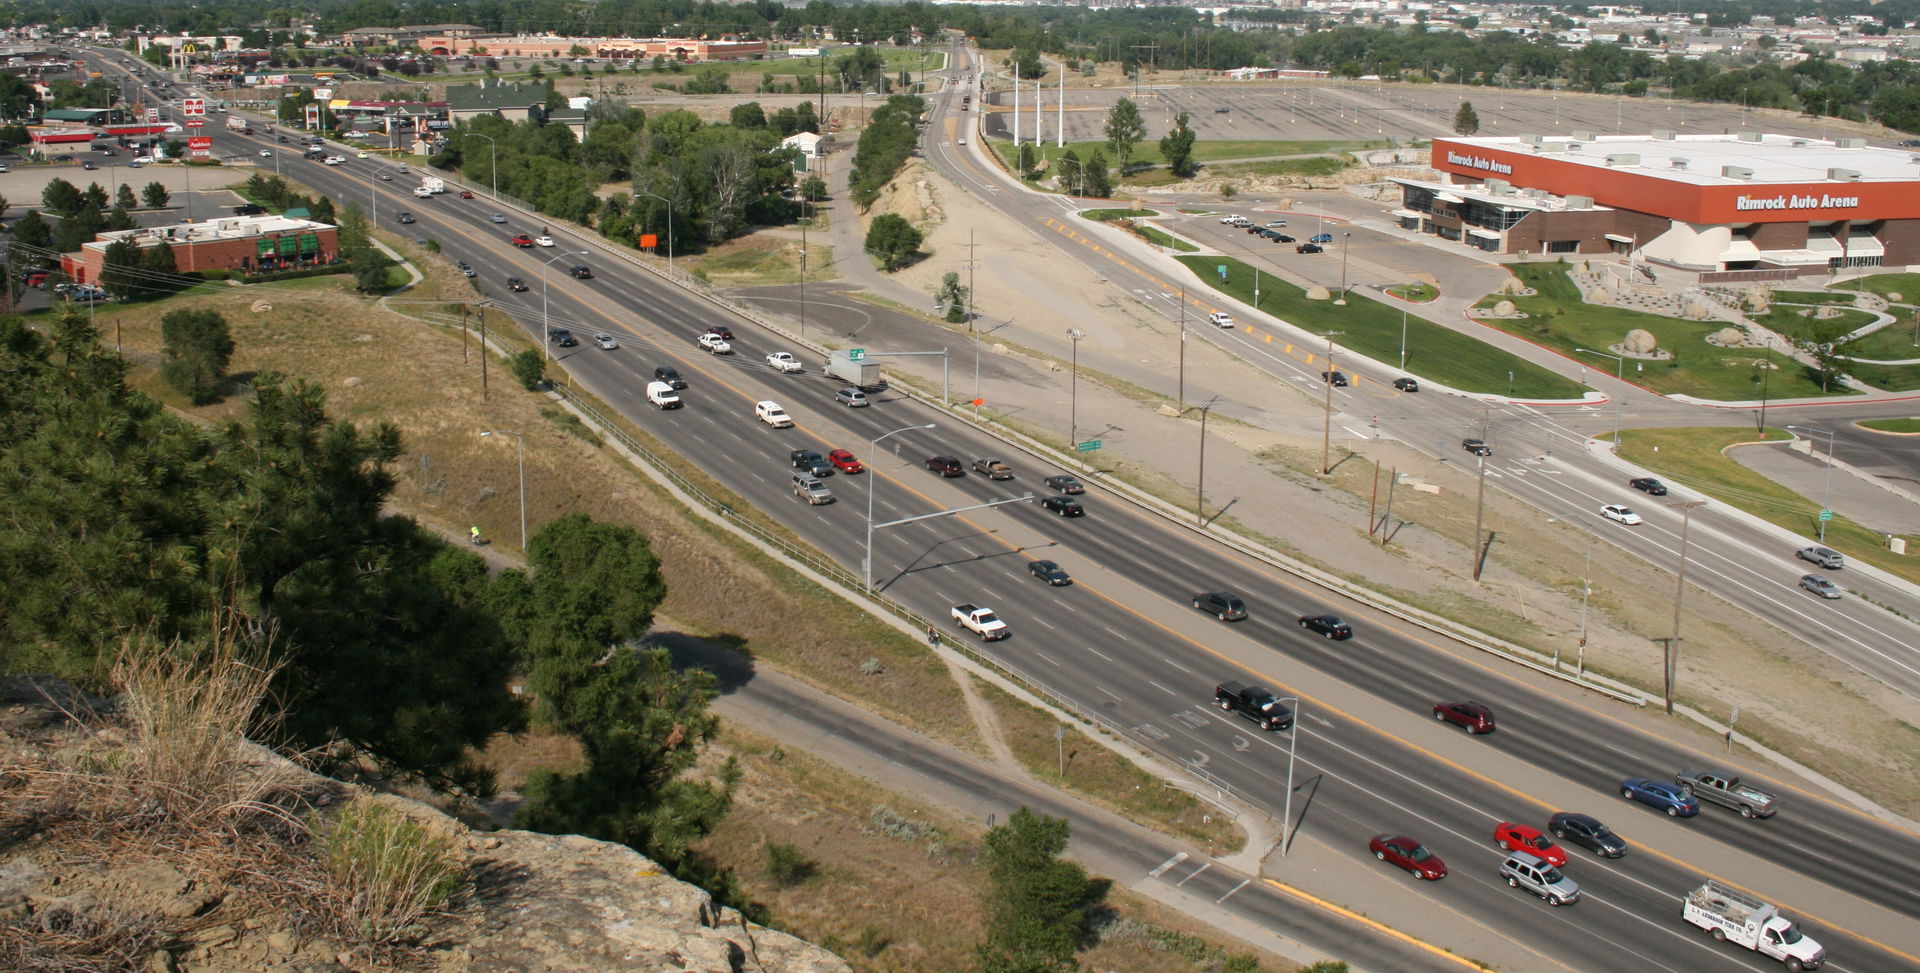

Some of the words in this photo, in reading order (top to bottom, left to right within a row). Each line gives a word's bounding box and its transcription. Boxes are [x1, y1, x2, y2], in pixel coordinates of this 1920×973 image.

[1448, 151, 1473, 167] Rimrock
[1474, 156, 1489, 170] Auto
[1490, 159, 1512, 174] Arena
[1736, 194, 1787, 210] Rimrock
[1788, 194, 1818, 209] Auto
[1820, 193, 1859, 208] Arena
